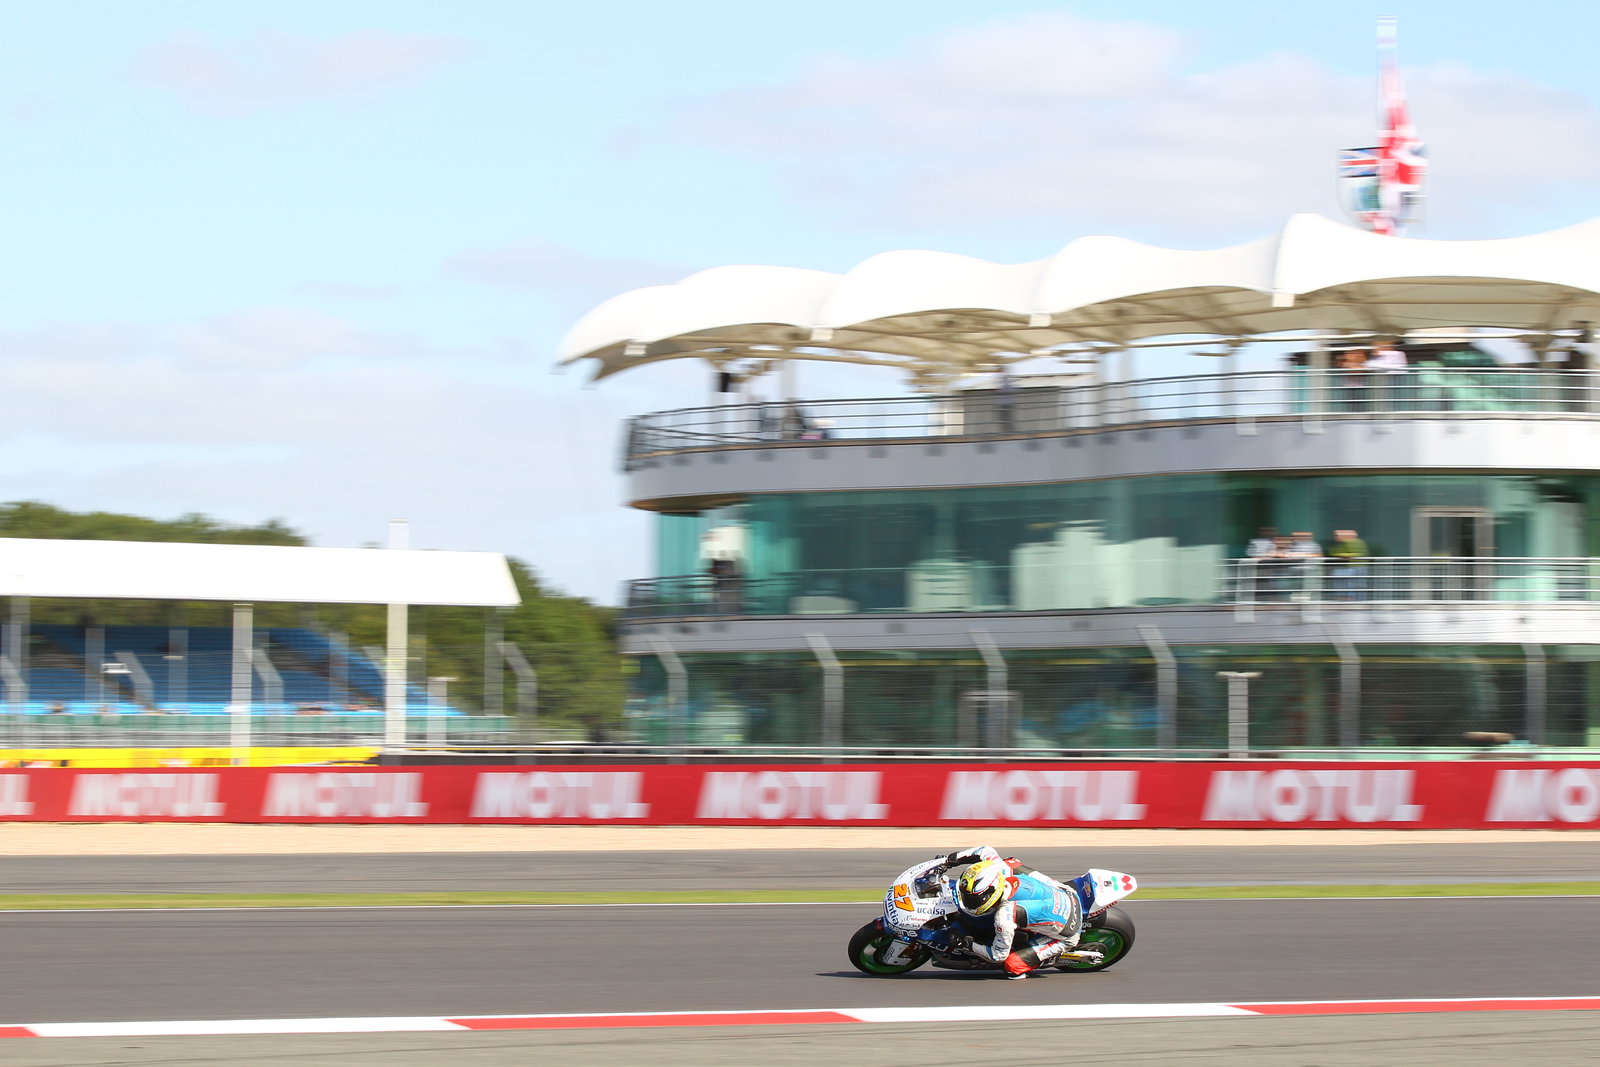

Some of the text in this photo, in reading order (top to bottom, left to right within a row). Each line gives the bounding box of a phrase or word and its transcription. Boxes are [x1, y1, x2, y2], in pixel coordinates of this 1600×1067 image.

[67, 774, 226, 816] MOTUL
[261, 773, 430, 817] MOTUL
[469, 772, 651, 818] MOTUL
[694, 771, 891, 819] MOTUL
[938, 770, 1148, 821] MOTUL
[1201, 770, 1424, 822] MOTUL
[893, 883, 915, 912] 27
[916, 906, 946, 916] ucalsa
